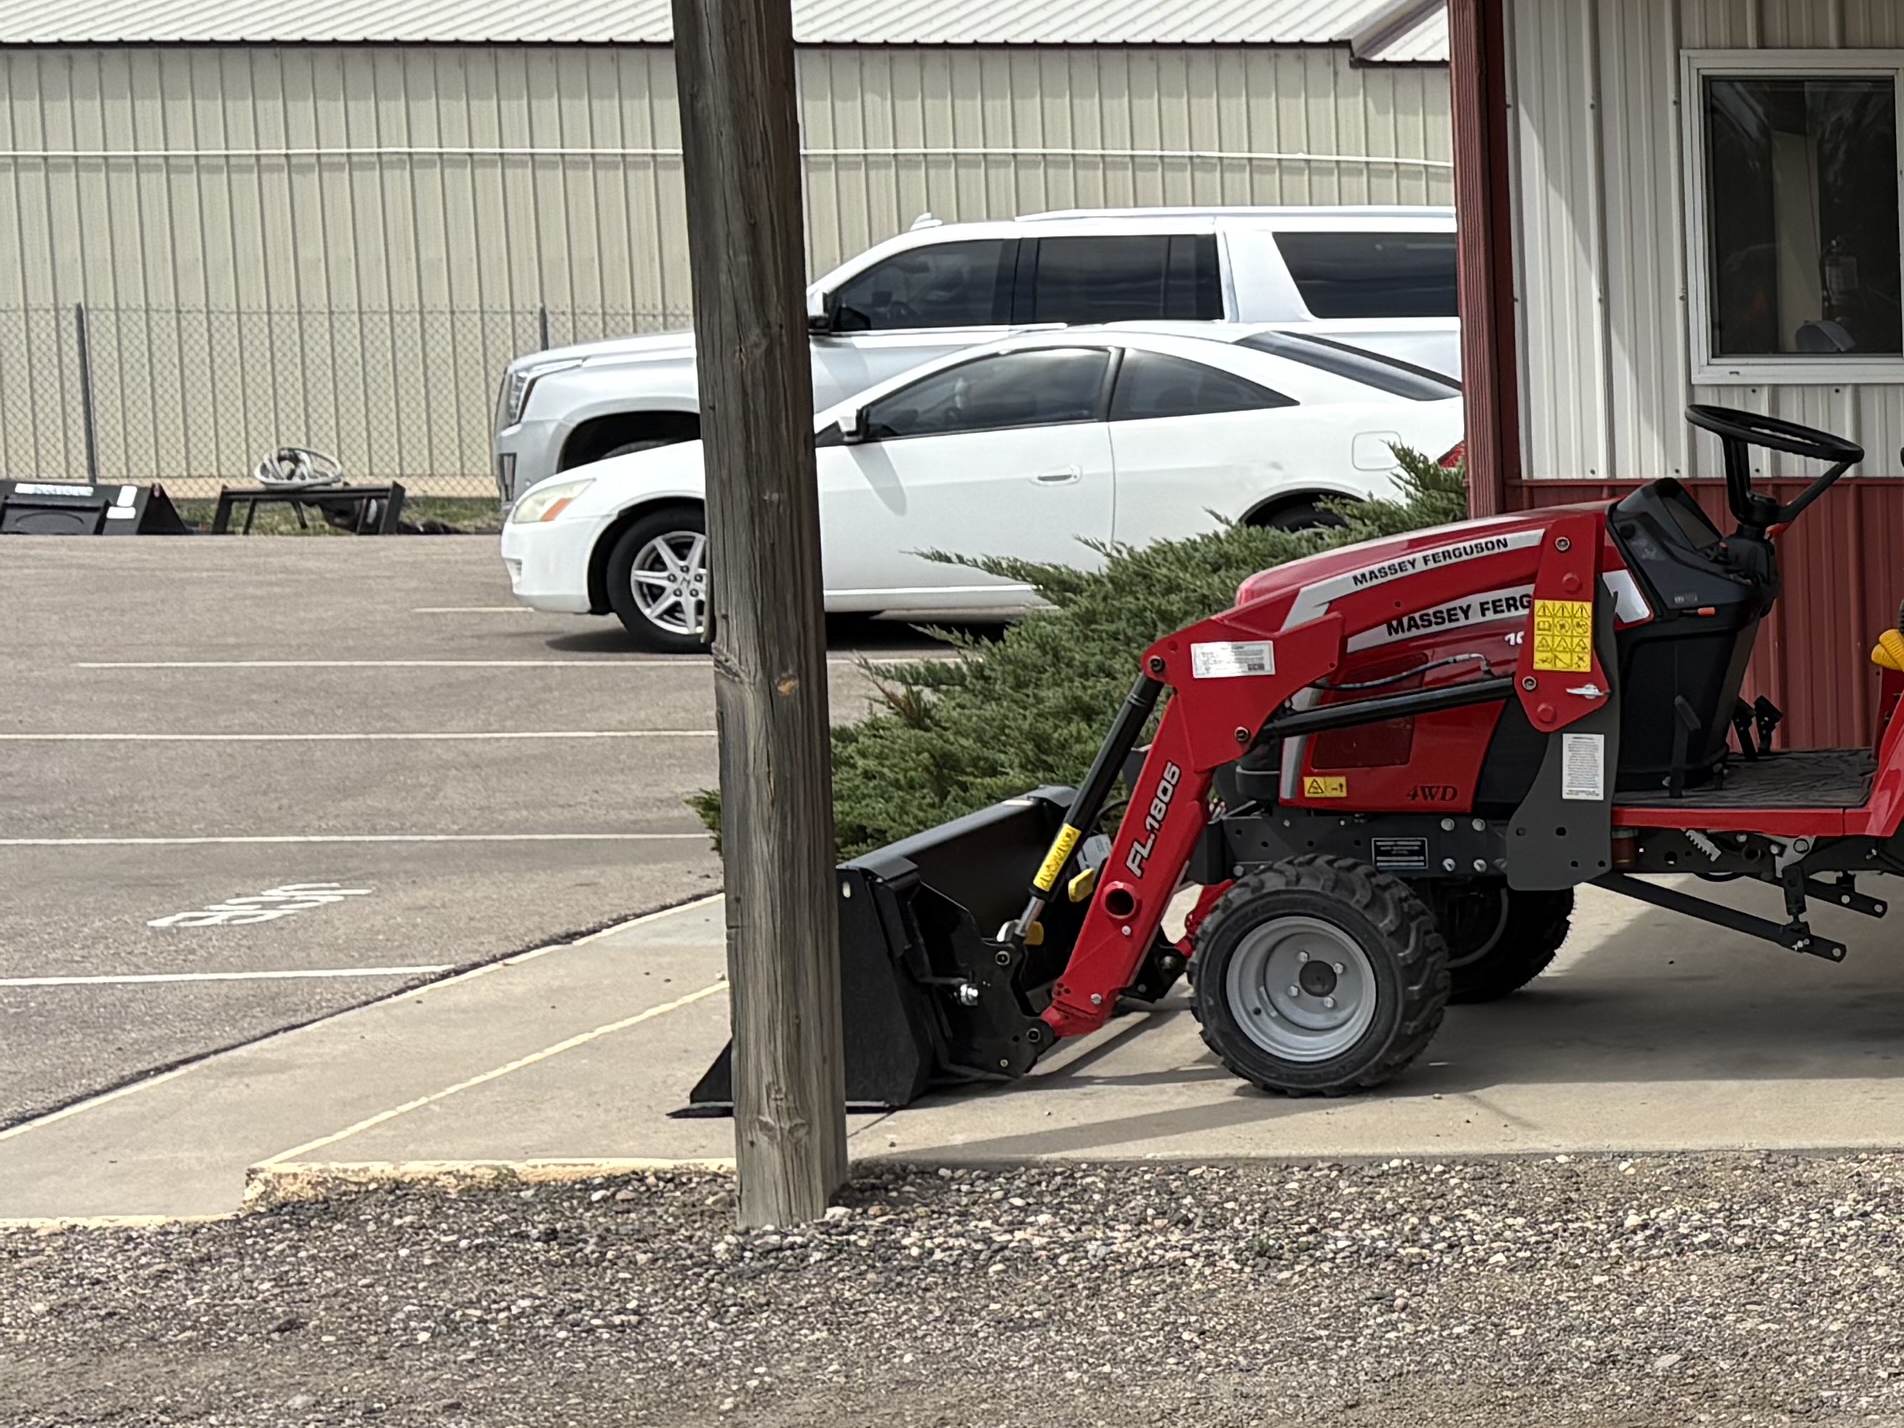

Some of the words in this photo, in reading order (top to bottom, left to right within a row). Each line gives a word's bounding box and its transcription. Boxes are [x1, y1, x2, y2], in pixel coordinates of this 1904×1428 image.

[1352, 558, 1417, 587] MASSEY
[1423, 537, 1509, 567] FERGUSON
[1386, 604, 1472, 637] MASSEY
[1479, 594, 1533, 618] FERG
[1406, 785, 1458, 802] 4WD
[1126, 760, 1180, 878] FL.1805
